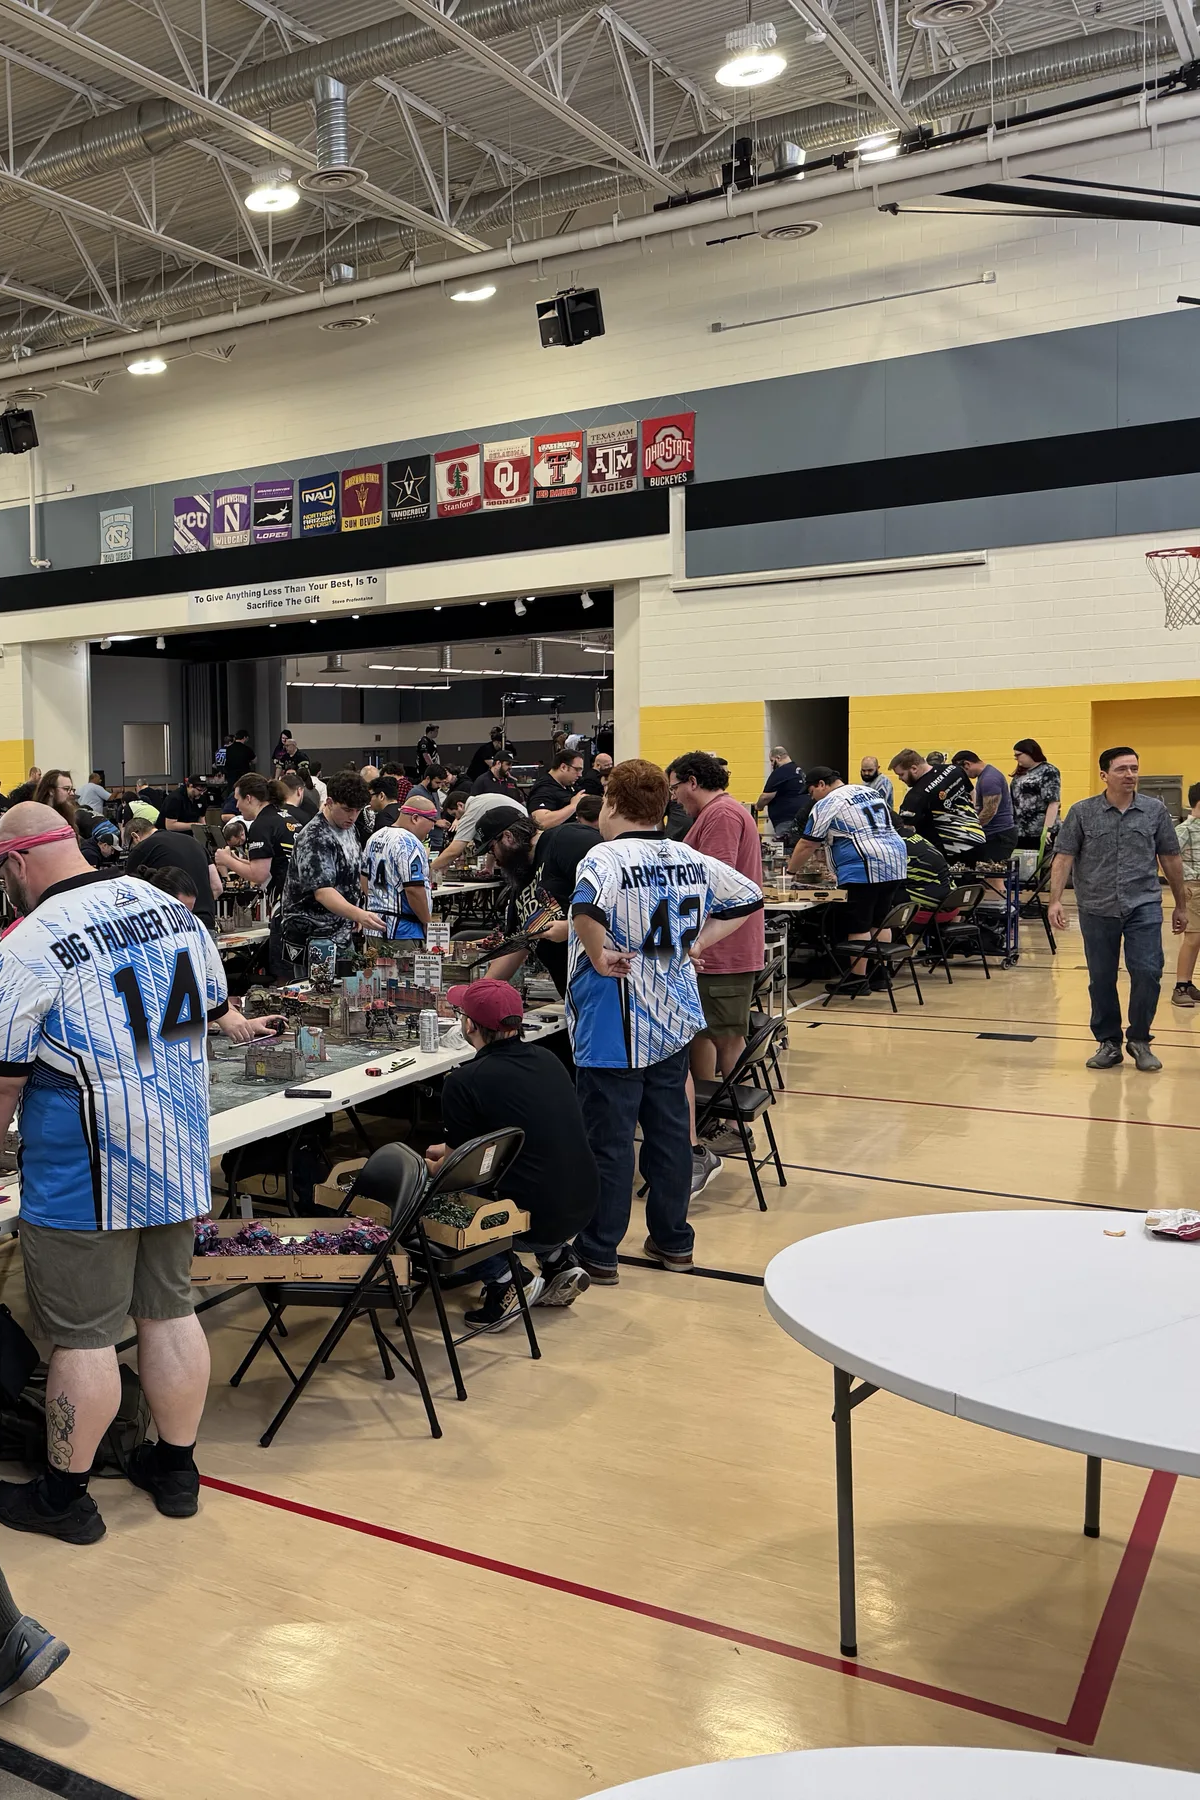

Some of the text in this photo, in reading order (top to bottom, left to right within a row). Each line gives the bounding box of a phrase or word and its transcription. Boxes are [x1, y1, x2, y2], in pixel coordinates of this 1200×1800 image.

[590, 432, 615, 442] TEXAS
[666, 437, 692, 463] STATE
[493, 461, 520, 498] OU
[590, 480, 634, 494] AGGIES
[650, 473, 688, 487] BUCKEYES
[403, 480, 415, 495] V
[305, 489, 333, 503] NAU
[485, 497, 527, 506] SOONERS
[390, 506, 428, 518] VANDERBILT
[443, 499, 474, 512] Stanford
[175, 511, 208, 529] TCU
[224, 503, 240, 533] N
[344, 518, 358, 529] SUN
[359, 515, 381, 527] DEVILS
[215, 534, 248, 546] WILDCATS
[256, 531, 289, 539] LOPES
[194, 575, 378, 604] To Give Anything Less Than Your Best, Is To
[246, 594, 320, 611] Sacrifice The Gift
[862, 803, 891, 829] 17
[50, 902, 198, 970] BIG THUNDER DADD
[640, 893, 703, 965] 42
[111, 946, 206, 1080] 14
